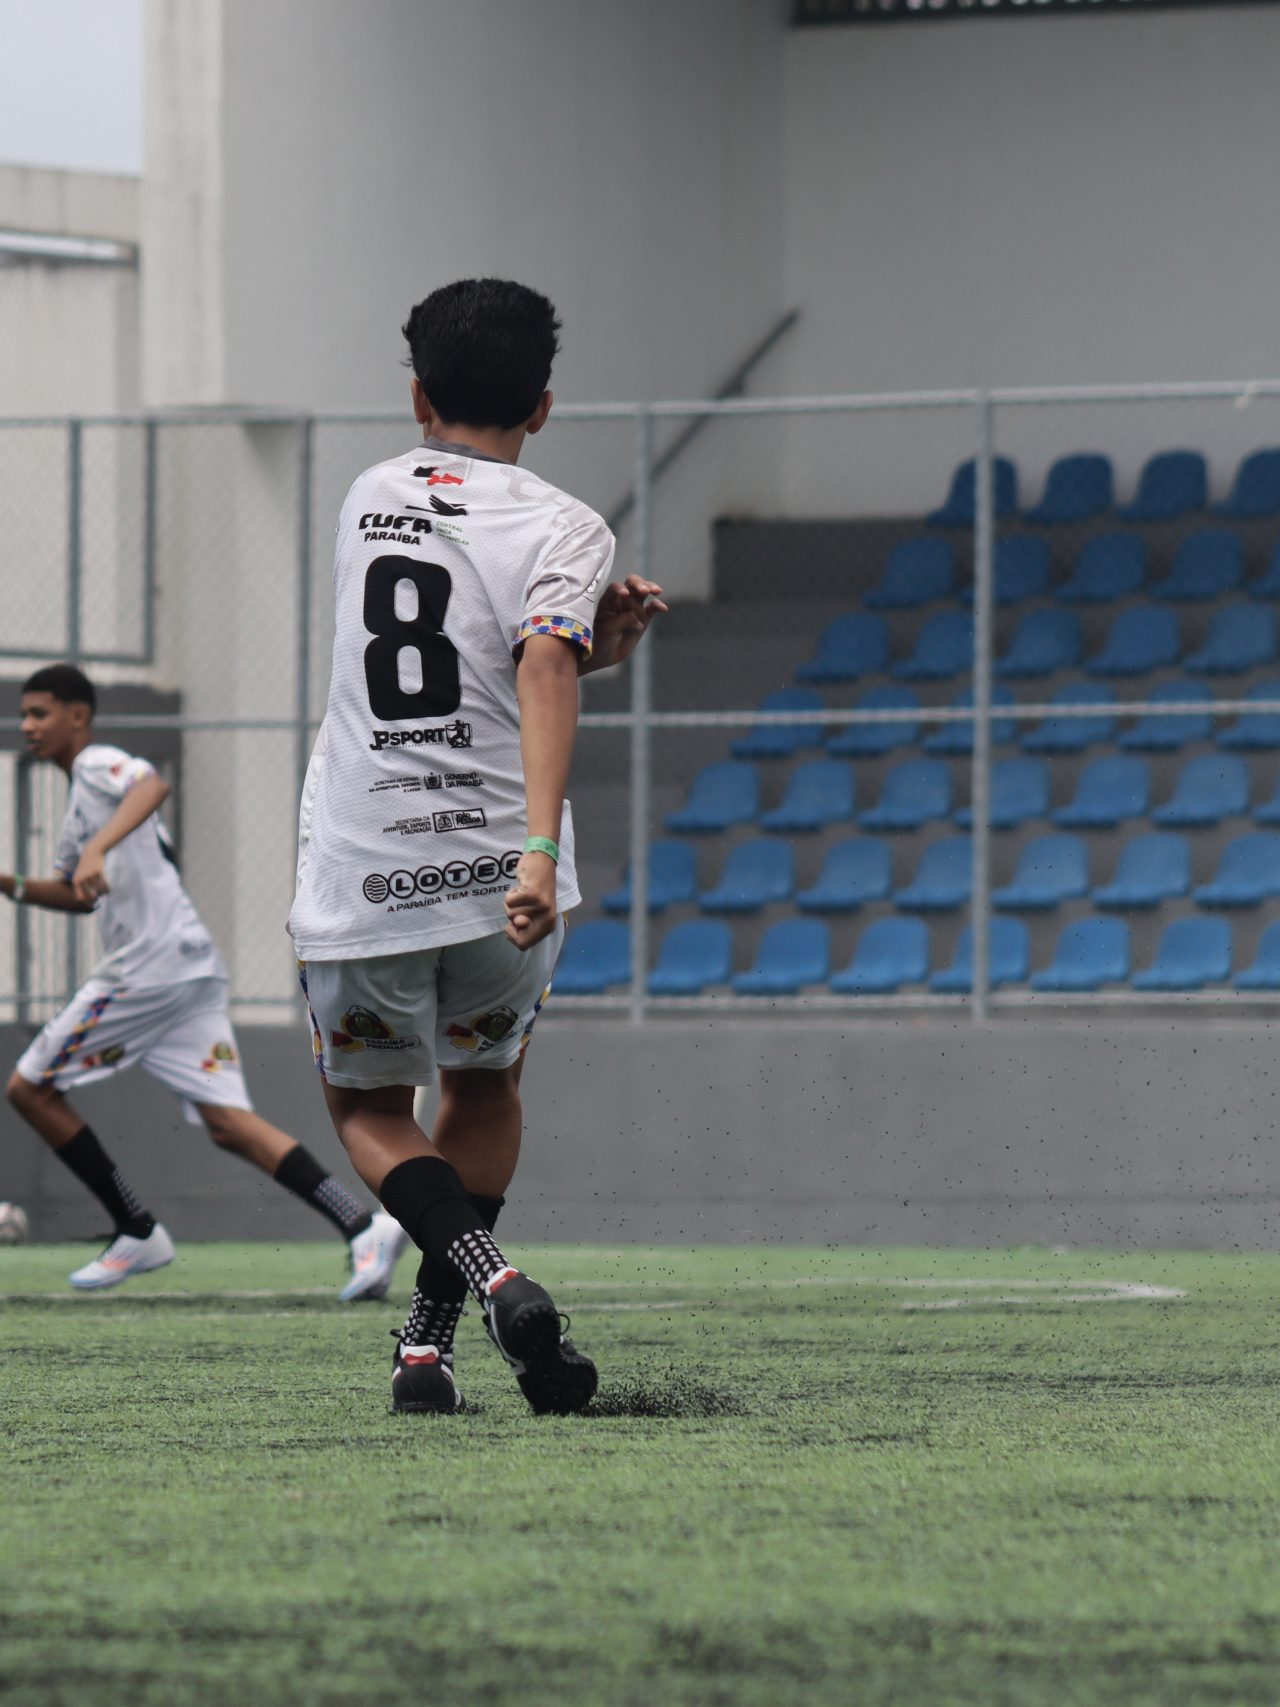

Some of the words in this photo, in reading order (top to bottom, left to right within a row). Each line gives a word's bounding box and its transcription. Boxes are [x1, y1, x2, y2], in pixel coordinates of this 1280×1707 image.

[359, 513, 432, 533] CUFA
[364, 530, 420, 545] PARAÍBA
[363, 555, 460, 721] 8
[444, 772, 477, 781] GOVERNO
[445, 780, 456, 788] DA
[386, 905, 395, 913] A
[396, 896, 442, 912] PARAÍBA
[445, 891, 468, 901] TEM
[471, 884, 511, 896] SORTE
